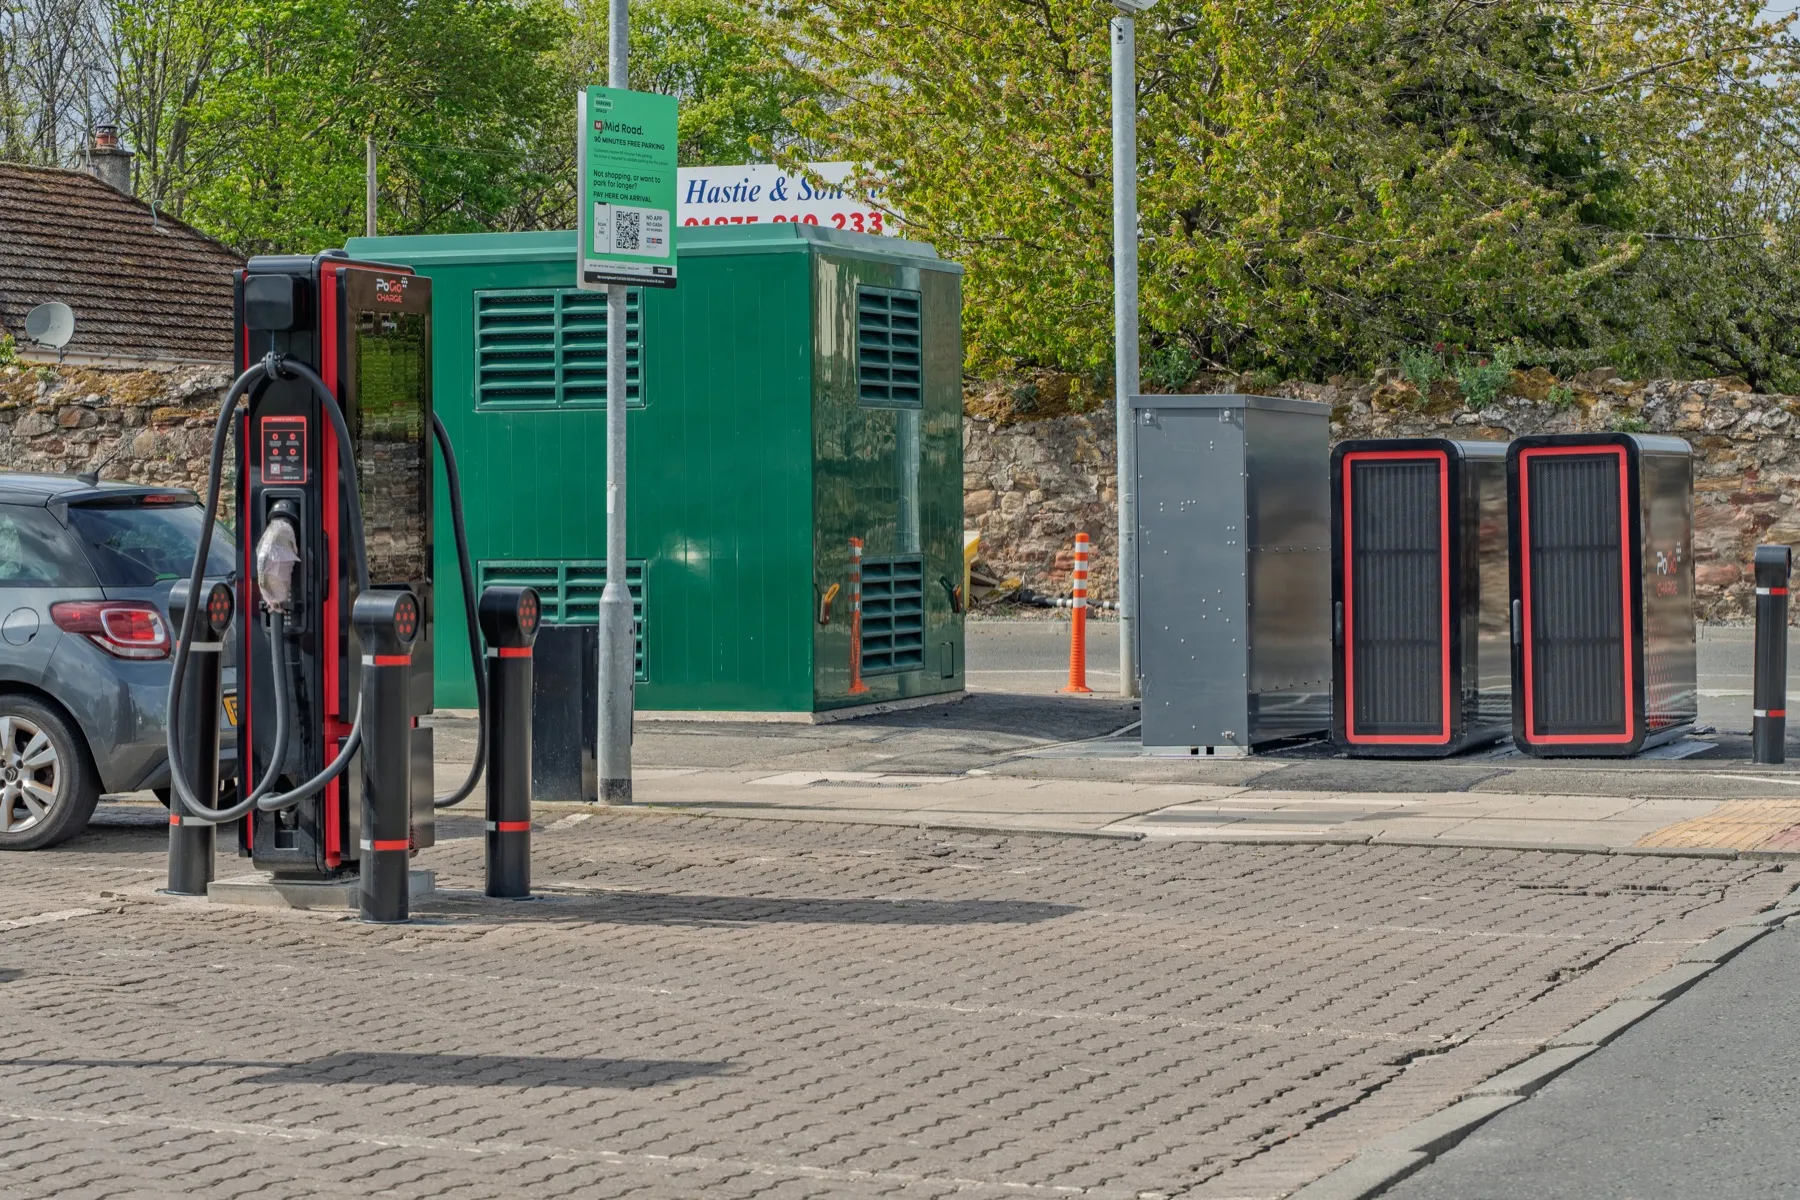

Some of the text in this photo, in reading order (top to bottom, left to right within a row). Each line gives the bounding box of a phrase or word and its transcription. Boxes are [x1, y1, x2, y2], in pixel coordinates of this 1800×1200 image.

[605, 121, 644, 135] Mid Road.
[602, 137, 627, 146] MINUTES
[641, 142, 665, 151] PARKING
[593, 169, 604, 177] Not
[640, 175, 654, 183] want
[593, 179, 638, 190] park for longer?
[684, 177, 761, 204] Hastie
[769, 176, 788, 202] &
[605, 192, 619, 200] HERE
[629, 195, 652, 203] ARRIVAL
[831, 212, 883, 234] 233
[376, 278, 402, 293] PoGo
[376, 293, 403, 303] CHARGE
